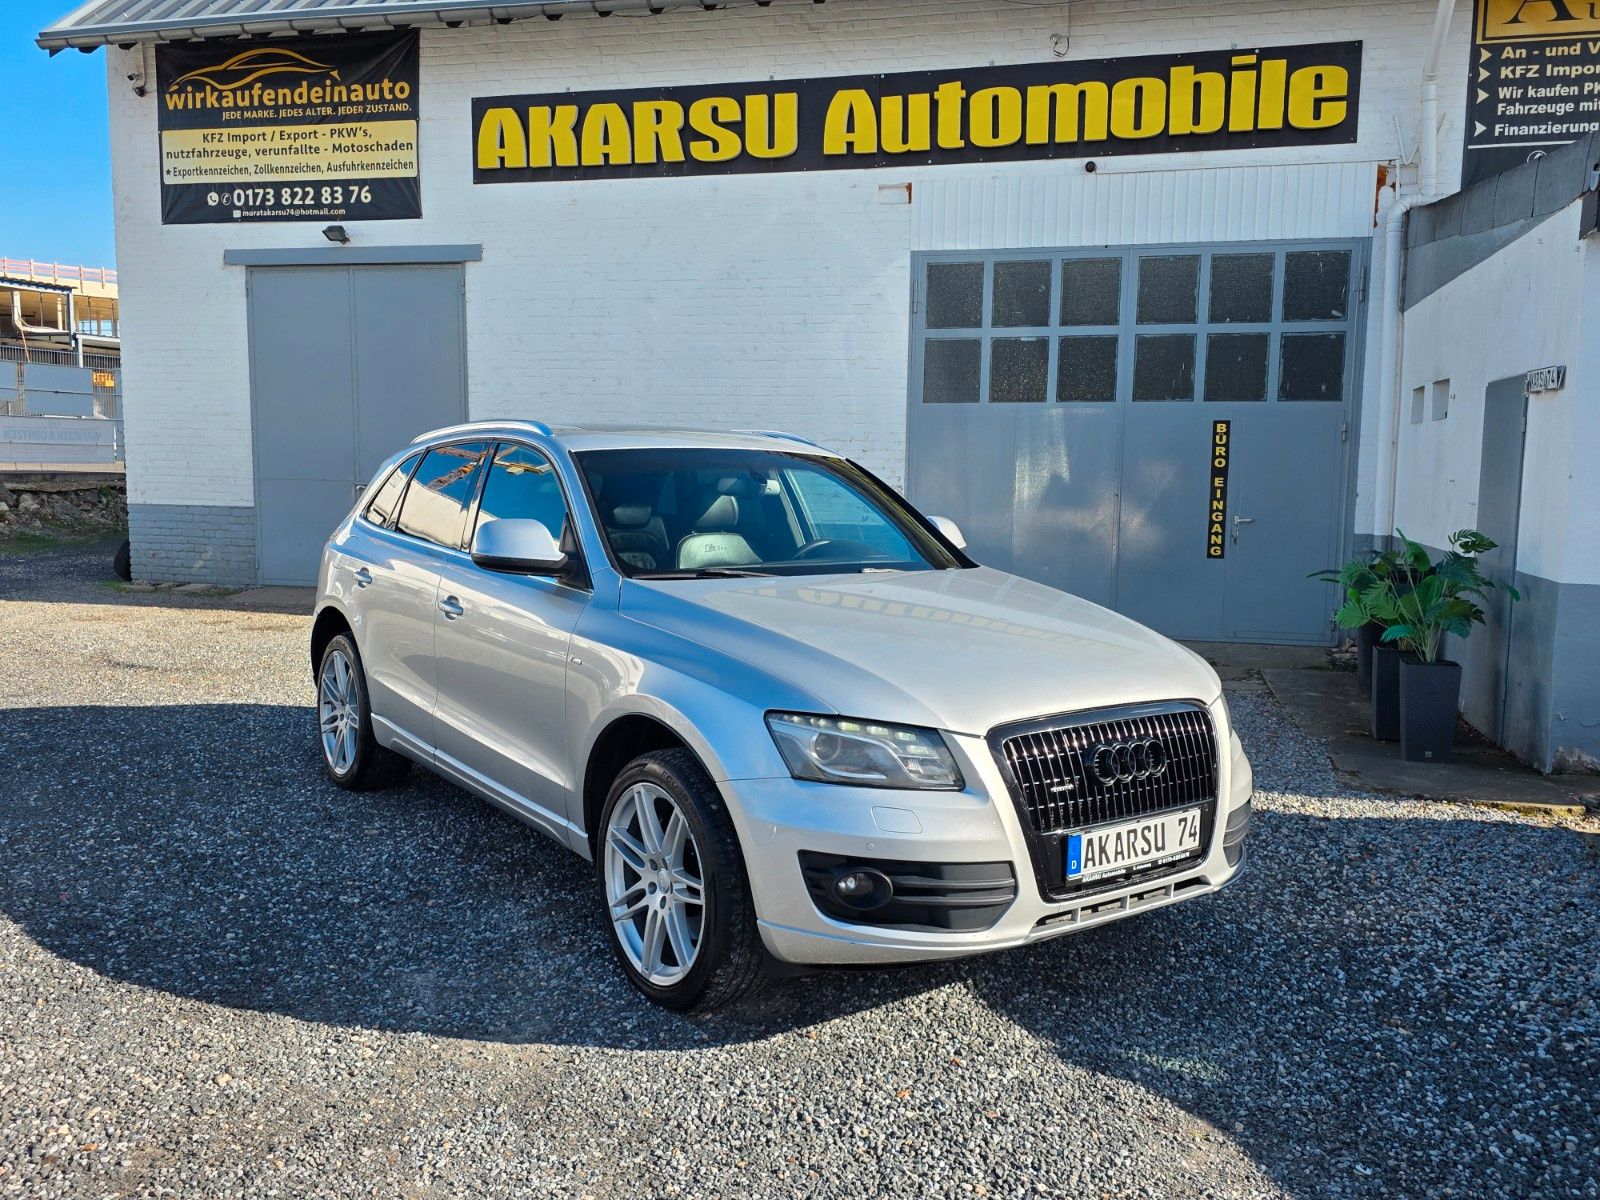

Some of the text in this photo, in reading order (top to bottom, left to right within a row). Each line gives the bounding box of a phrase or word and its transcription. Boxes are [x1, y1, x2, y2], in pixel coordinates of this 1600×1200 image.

[1501, 46, 1527, 59] An
[1545, 42, 1581, 57] und
[1500, 65, 1540, 79] KFZ
[165, 79, 410, 110] wirkaufendeinauto
[1498, 86, 1524, 99] Wir
[1527, 84, 1579, 98] kaufen
[222, 103, 412, 121] JEDE MARKE. JEDES ALTER. JEDER ZUSTAND.
[477, 54, 1348, 169] AKARSU Automobile
[1497, 102, 1575, 116] Fahrzeuge
[202, 133, 224, 143] KFZ
[227, 131, 267, 145] Import
[279, 129, 319, 143] Export
[166, 147, 252, 160] nutzfahrzeuge,
[254, 143, 320, 157] verunfallte
[332, 140, 413, 154] Motoschaden
[173, 158, 414, 179] Exportkennzeichen, Zollkennzeichen, Ausfuhrkennzeichen
[233, 185, 373, 207] 0173 822 83 76
[1210, 423, 1228, 556] BÜRO EINGANG
[1083, 814, 1198, 869] AKARSU 74
[1071, 860, 1078, 869] D
